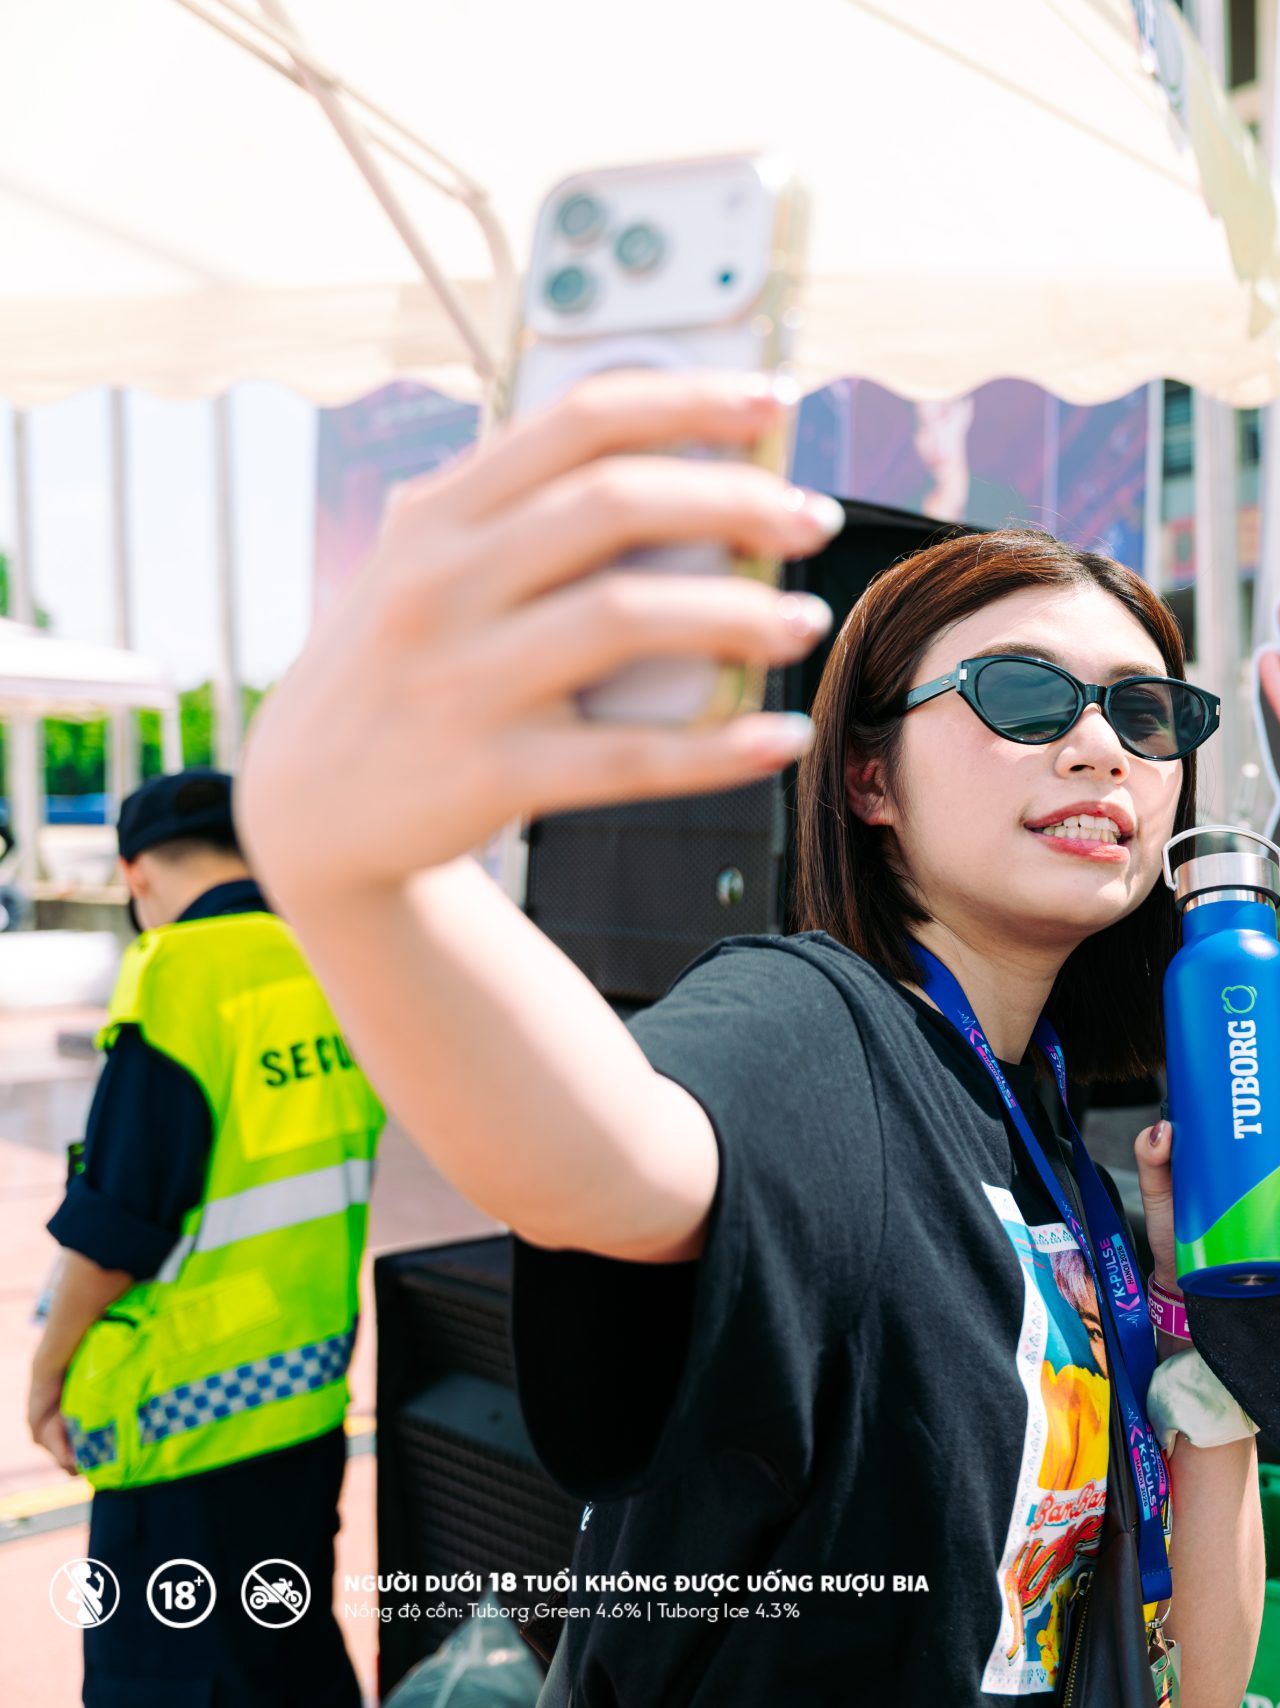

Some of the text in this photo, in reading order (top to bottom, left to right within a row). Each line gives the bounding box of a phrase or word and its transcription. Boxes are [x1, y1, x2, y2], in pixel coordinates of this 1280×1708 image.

[1228, 1019, 1263, 1140] TUBORG
[1100, 1237, 1126, 1298] K-PULSE
[1123, 1262, 1135, 1285] HANOI
[1139, 1443, 1159, 1519] K-PULSE
